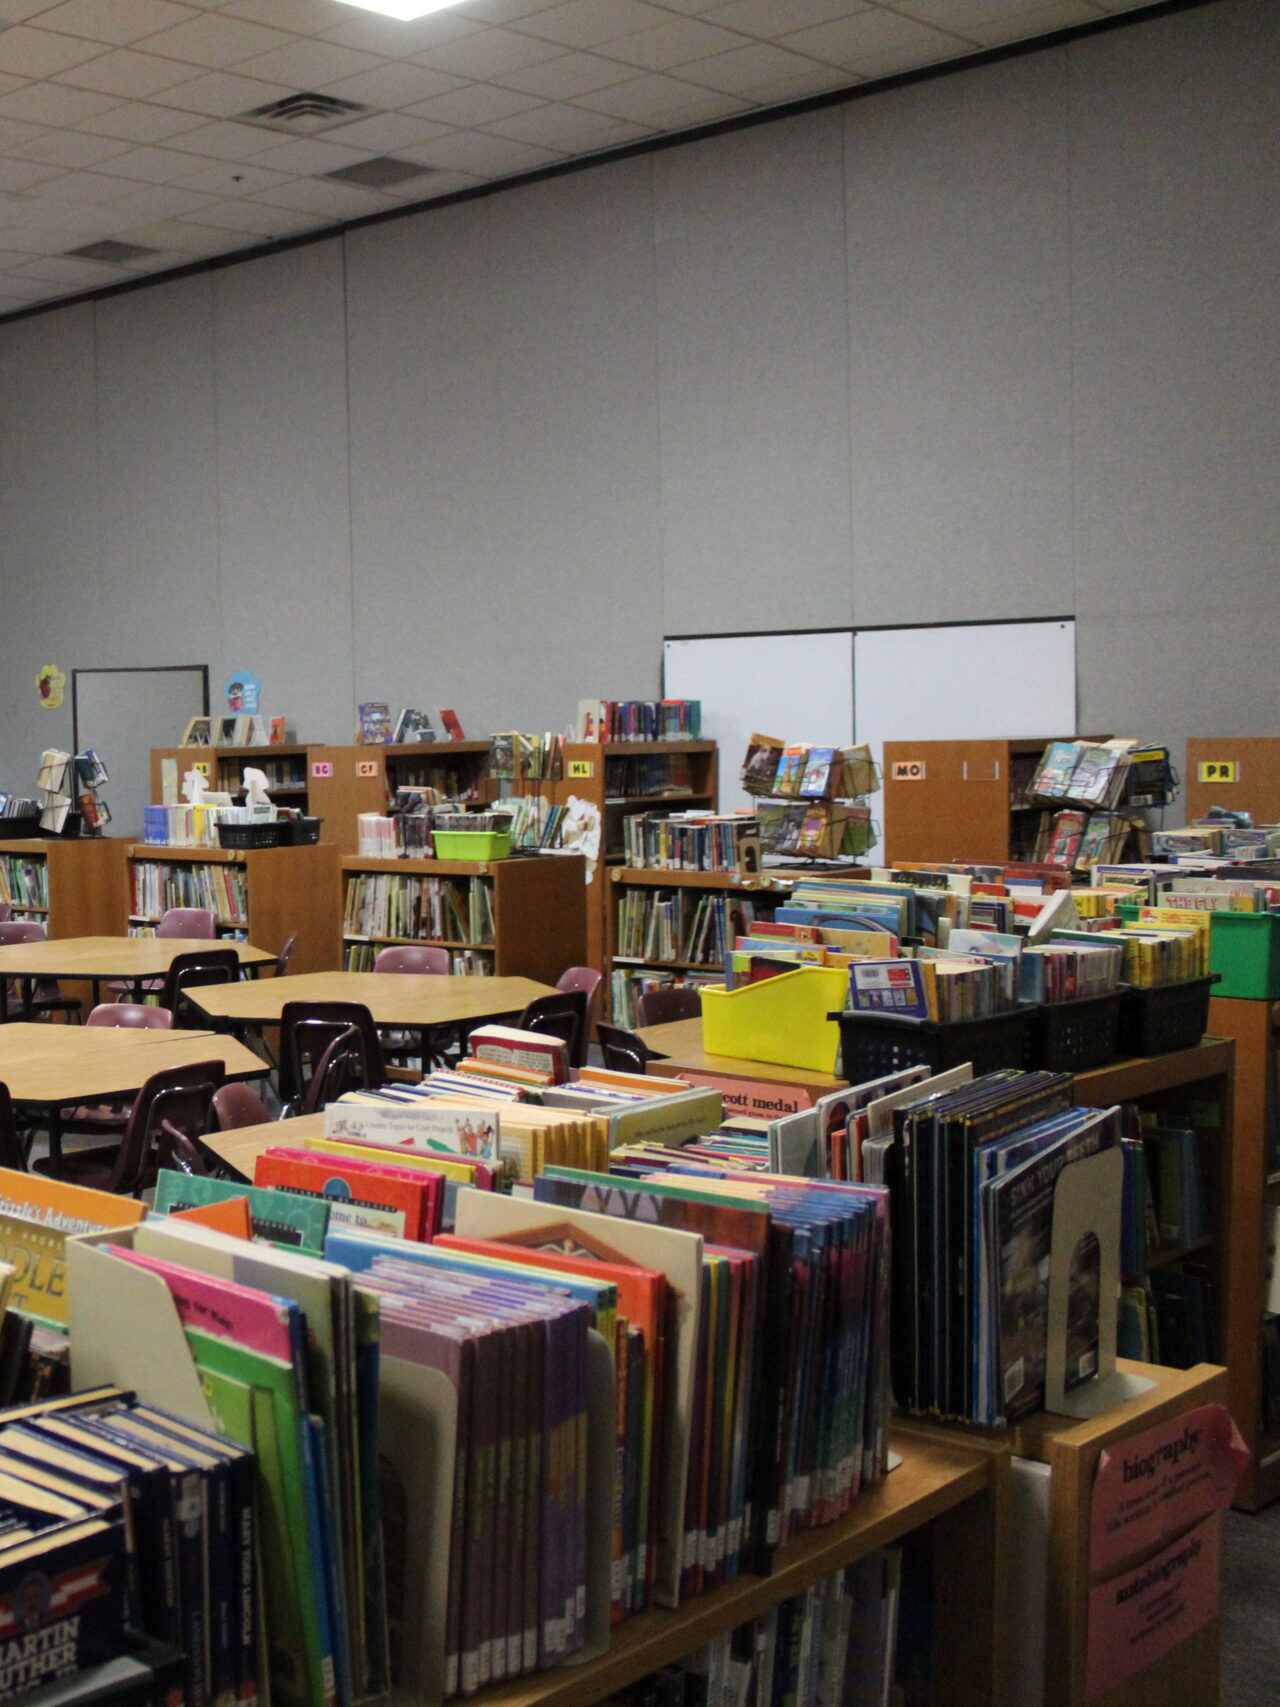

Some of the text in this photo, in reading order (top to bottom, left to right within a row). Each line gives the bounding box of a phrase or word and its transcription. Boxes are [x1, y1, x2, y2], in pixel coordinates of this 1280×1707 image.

[897, 765, 920, 776] MO
[1207, 765, 1229, 778] PR
[1166, 897, 1217, 910] THE FLY
[752, 1097, 799, 1113] medal
[1123, 1427, 1202, 1484] biography
[1116, 1537, 1202, 1605] autobiography
